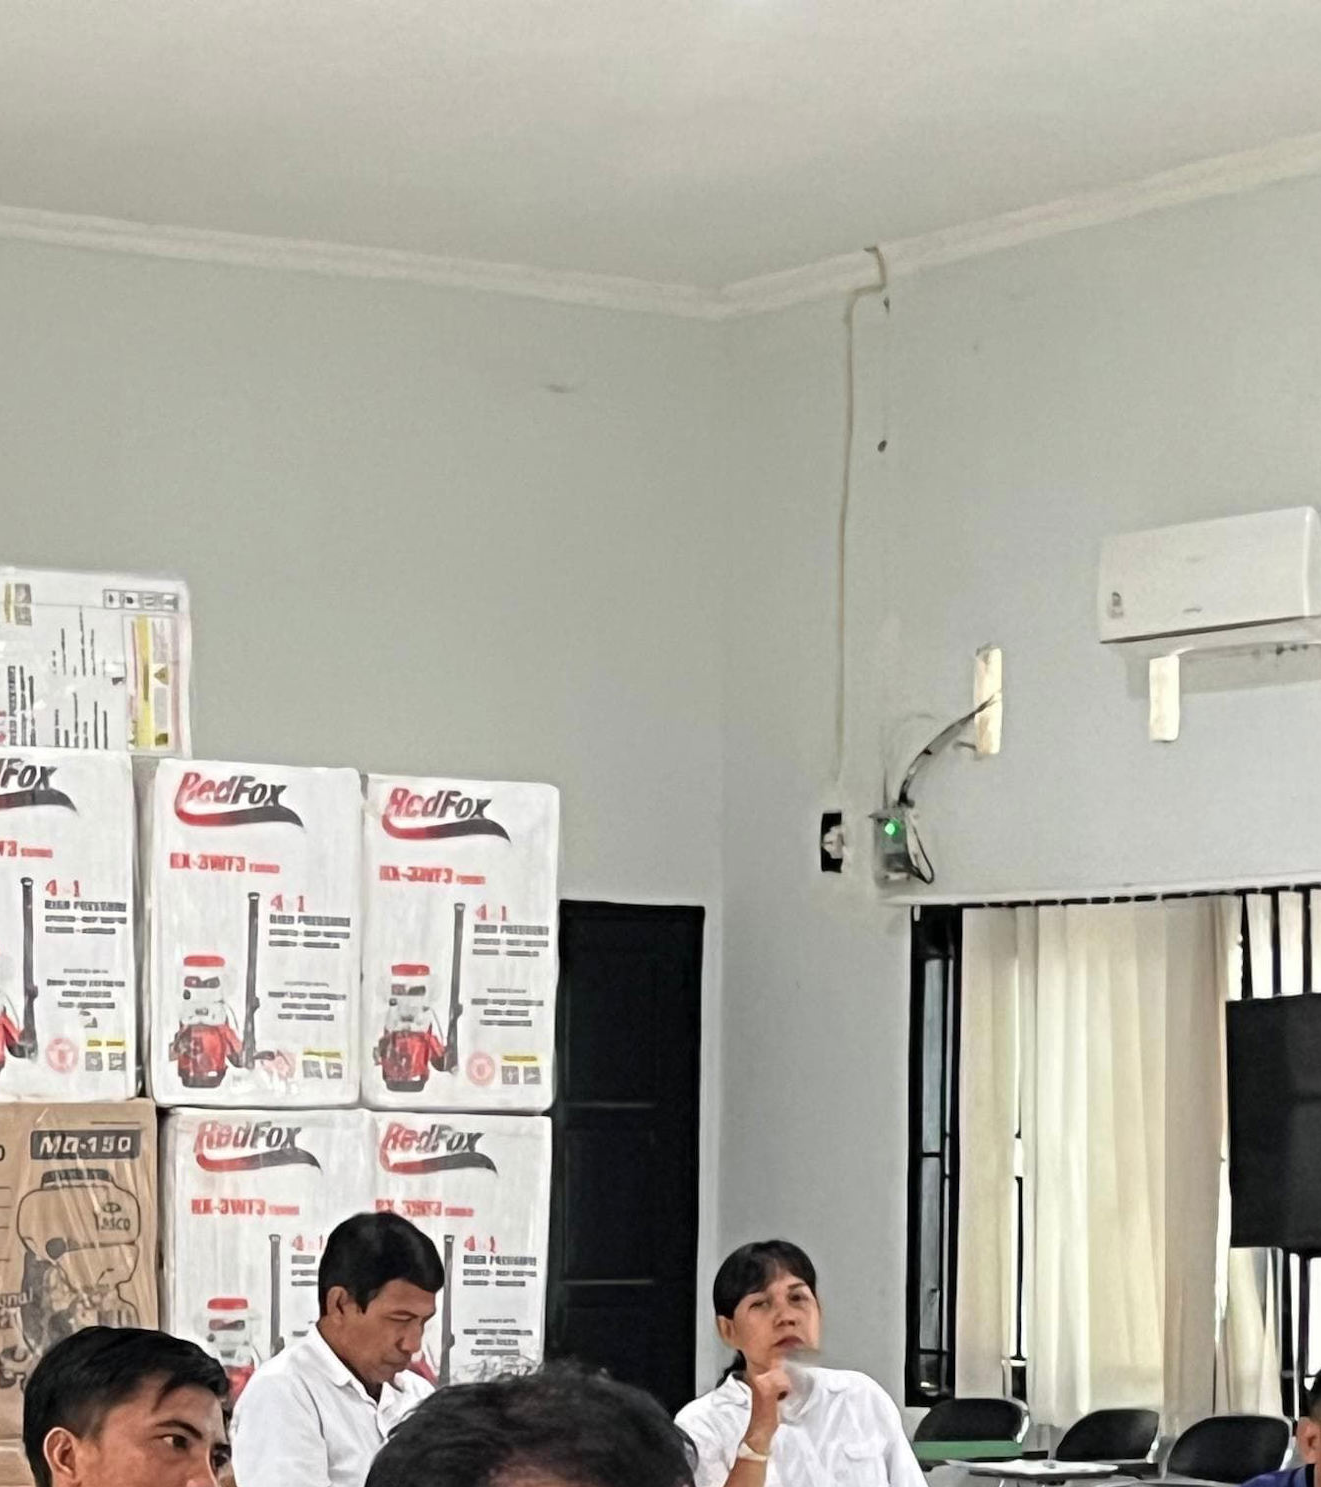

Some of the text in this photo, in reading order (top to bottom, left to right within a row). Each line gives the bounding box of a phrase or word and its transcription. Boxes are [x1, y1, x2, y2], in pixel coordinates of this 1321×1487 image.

[174, 772, 288, 808] RedFox
[381, 787, 494, 821] RedFox
[192, 1120, 303, 1152] RedFox
[380, 1122, 486, 1155] RedFox
